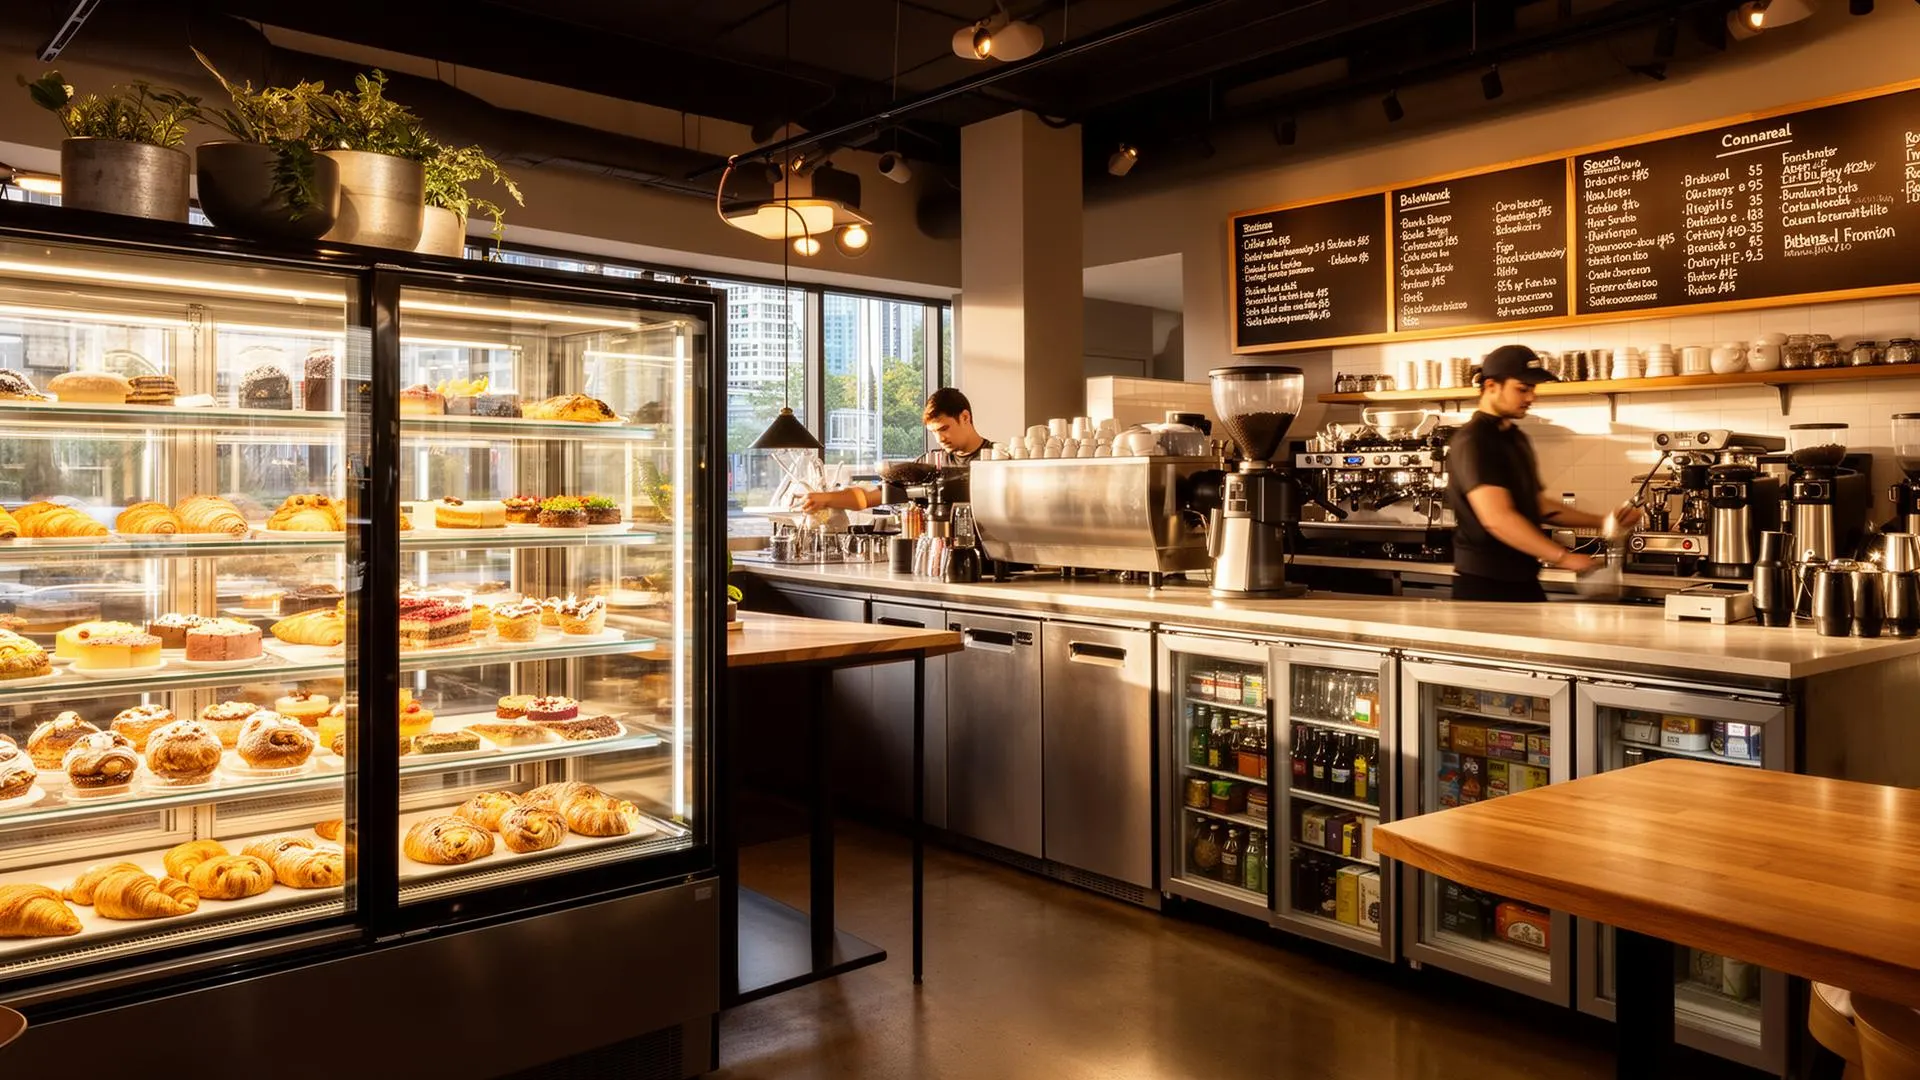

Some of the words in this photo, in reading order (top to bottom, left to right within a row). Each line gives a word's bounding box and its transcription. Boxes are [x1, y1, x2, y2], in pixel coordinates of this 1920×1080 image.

[1722, 122, 1792, 148] Connareal
[1748, 164, 1763, 176] 55
[1748, 178, 1764, 192] 95
[1749, 194, 1764, 206] 35
